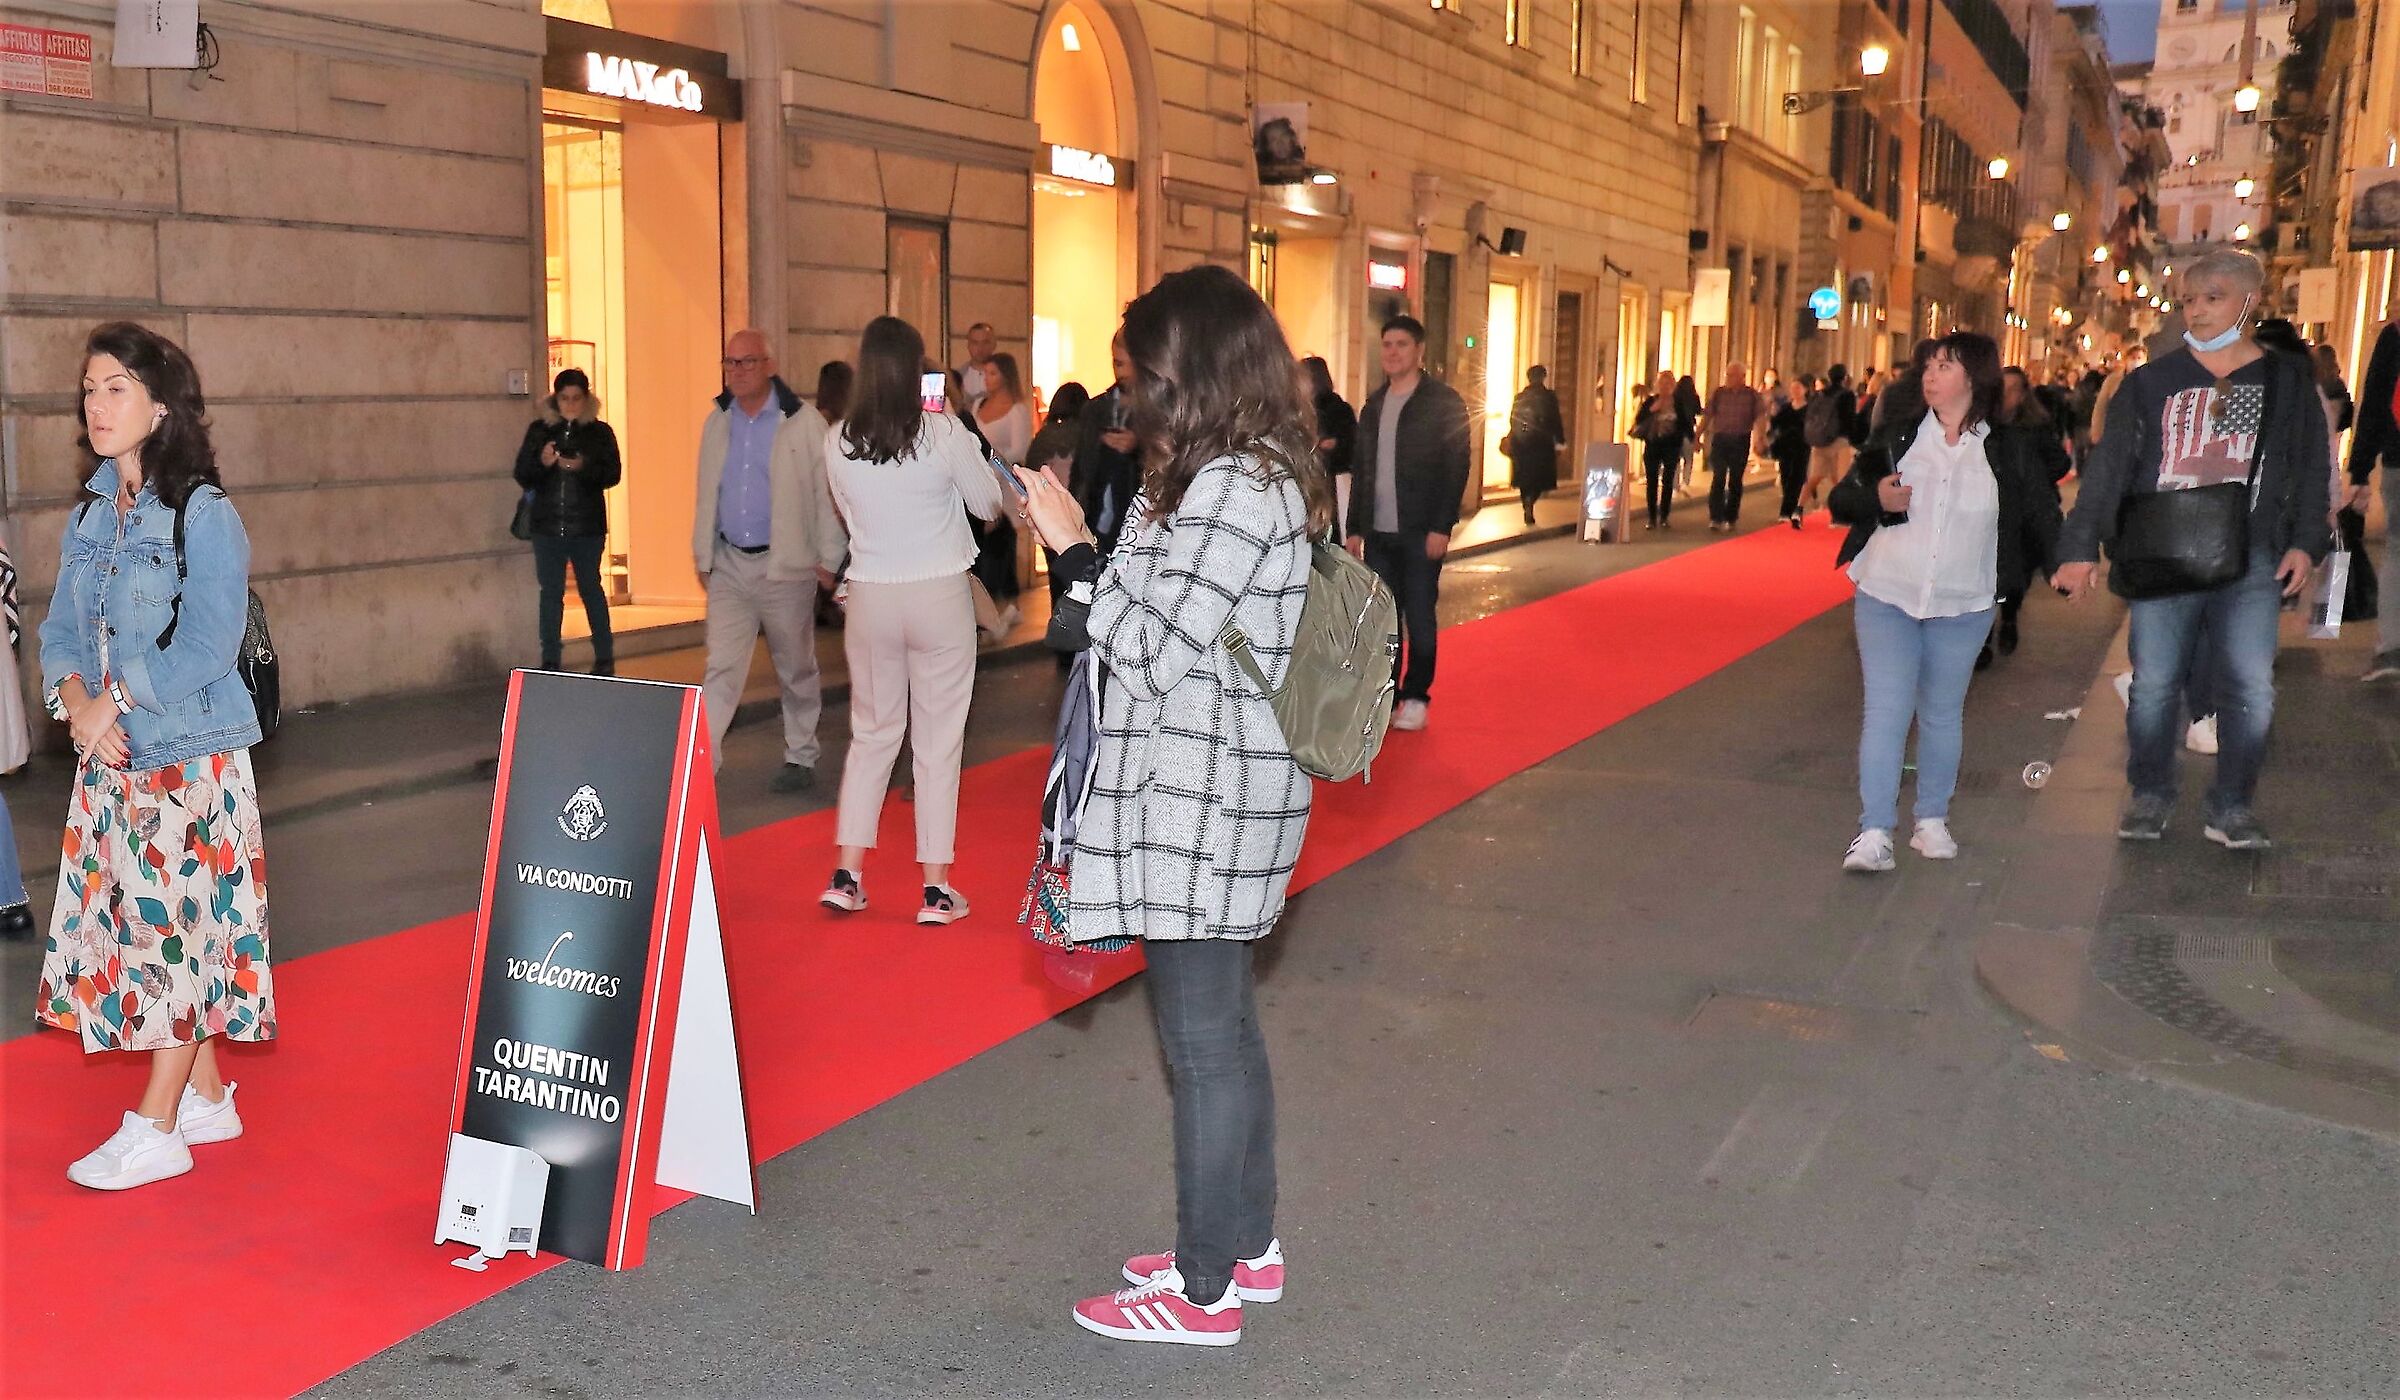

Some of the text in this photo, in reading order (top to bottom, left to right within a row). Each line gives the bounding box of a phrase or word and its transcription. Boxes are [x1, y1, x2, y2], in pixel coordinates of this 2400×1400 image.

[46, 34, 90, 58] AFFITTASI
[517, 863, 633, 900] VIA CONDOTTI
[506, 931, 621, 998] welcomes
[493, 1038, 610, 1087] QUENTIN
[475, 1066, 621, 1123] TARANTINO
